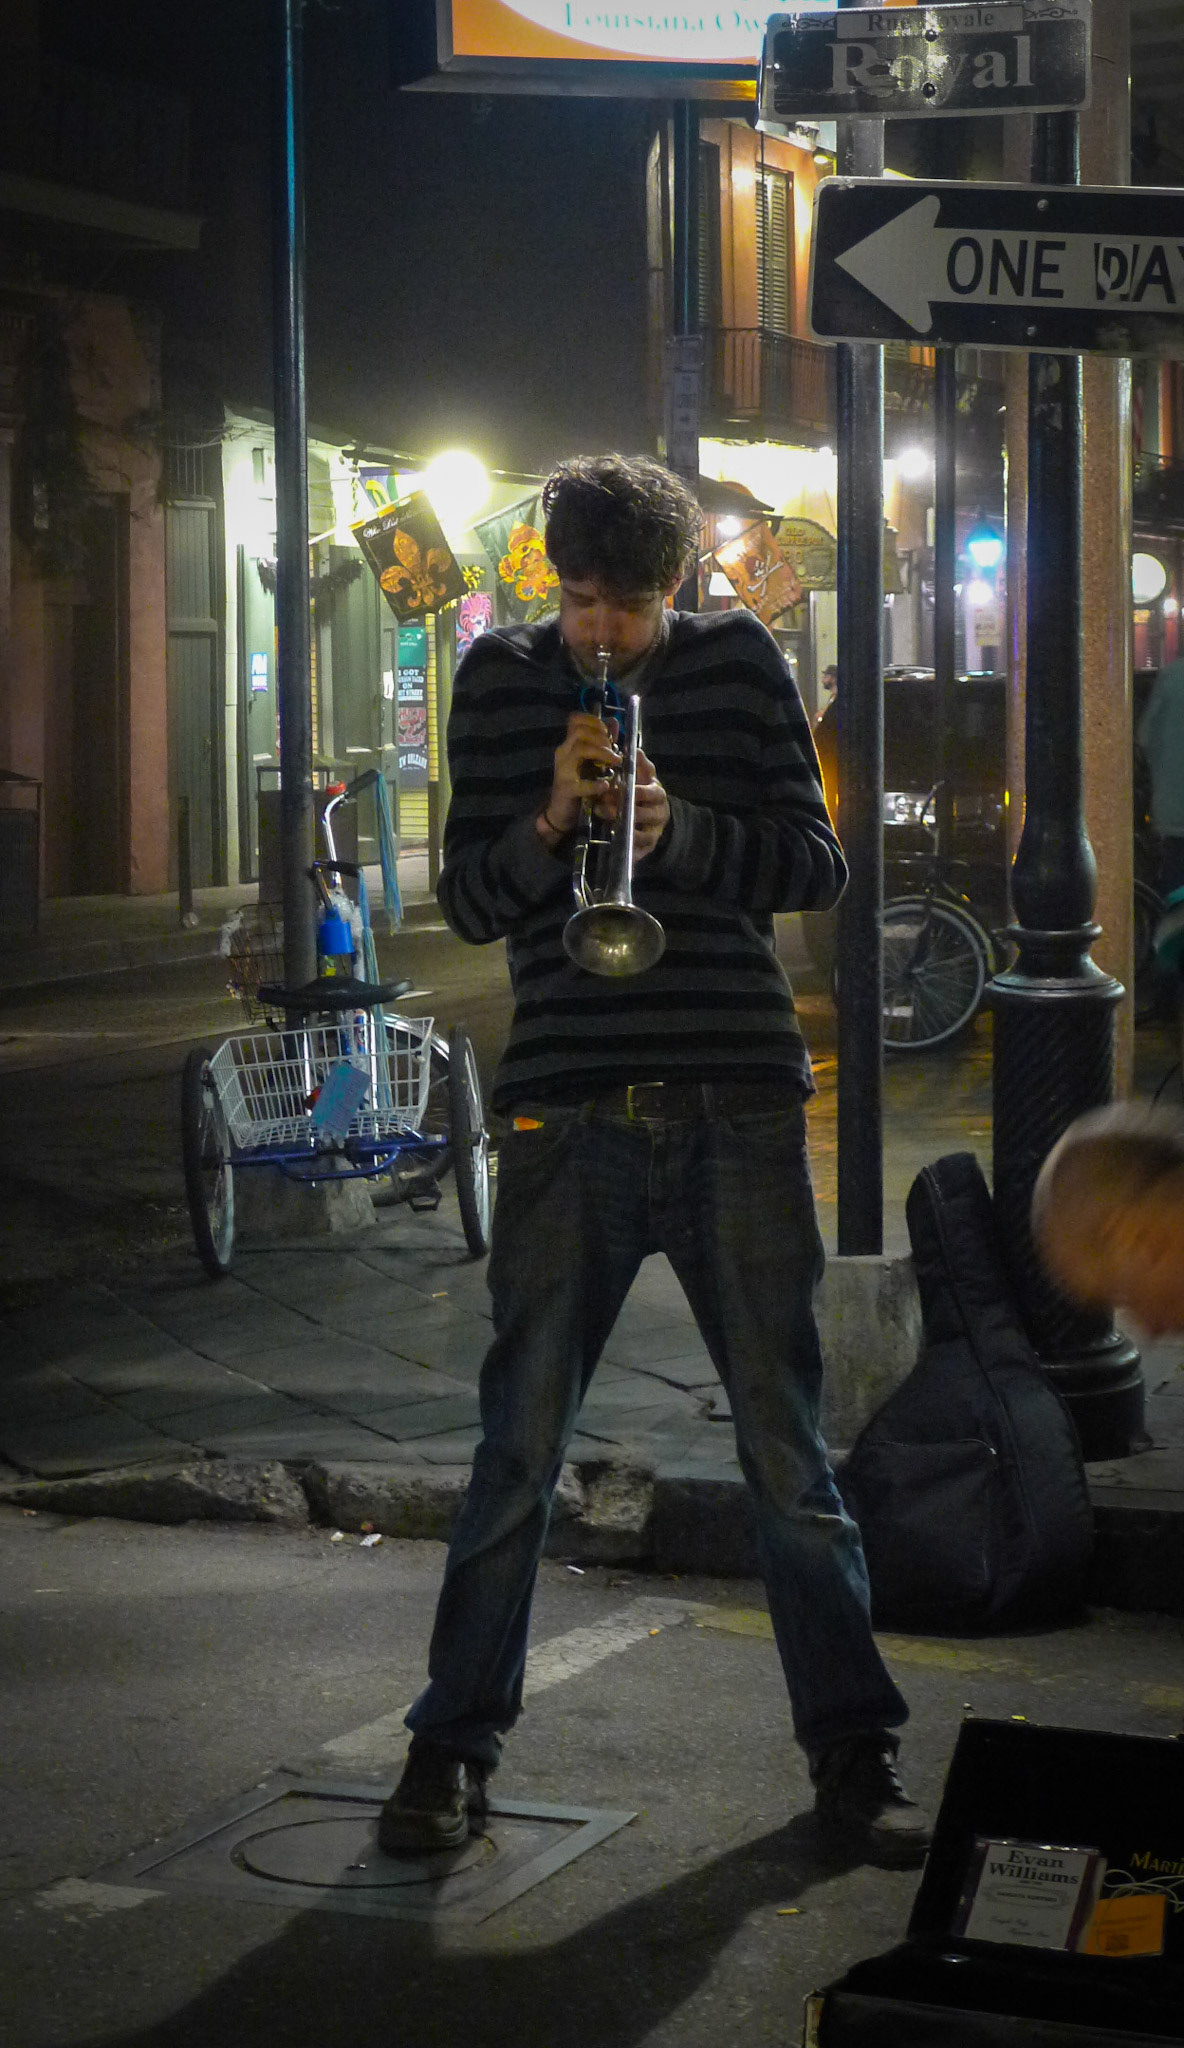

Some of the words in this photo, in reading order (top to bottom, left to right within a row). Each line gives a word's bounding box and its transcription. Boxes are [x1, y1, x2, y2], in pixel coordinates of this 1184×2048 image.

[923, 9, 995, 31] oyale
[826, 35, 1035, 104] Royal
[946, 236, 1066, 299] ONE
[1094, 242, 1184, 304] DA
[1007, 1849, 1064, 1869] Evan
[988, 1862, 1080, 1885] Williams
